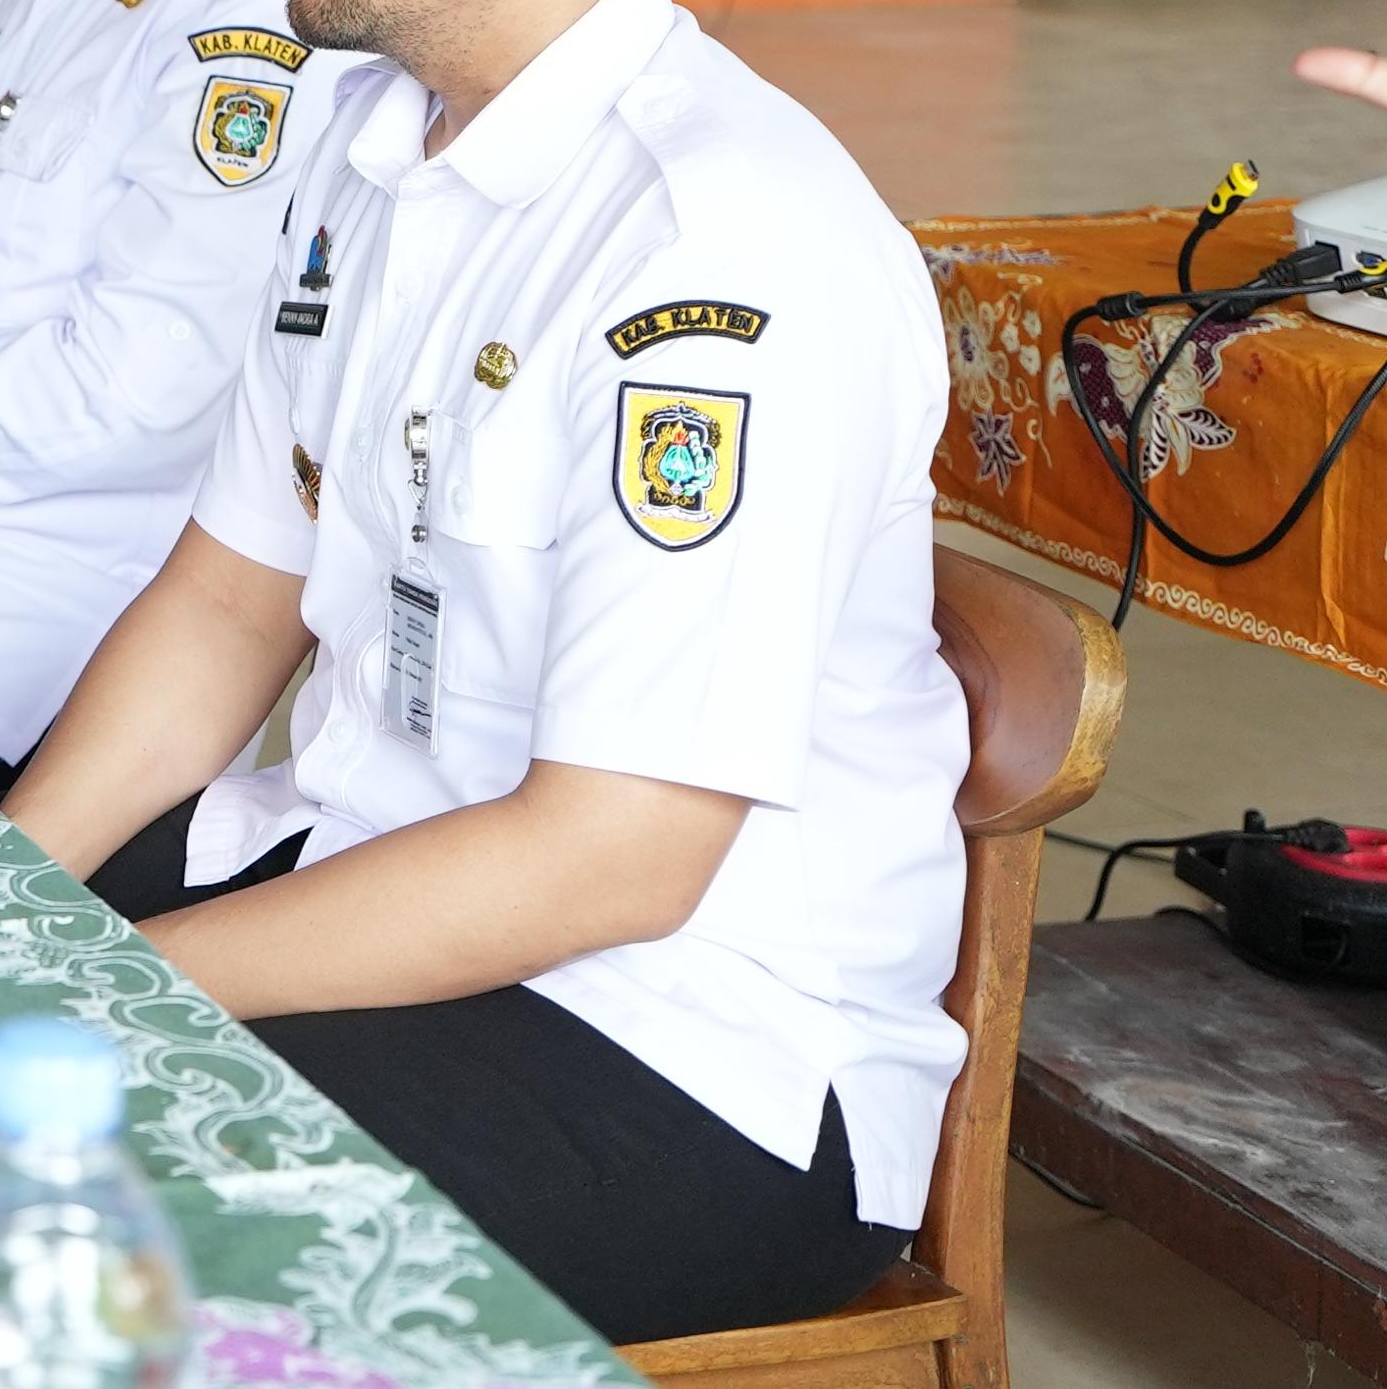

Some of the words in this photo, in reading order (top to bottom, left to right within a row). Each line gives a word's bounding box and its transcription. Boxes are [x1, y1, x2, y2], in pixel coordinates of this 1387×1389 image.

[198, 34, 239, 55] KAB.
[243, 33, 302, 65] KLATEN
[670, 306, 754, 334] KLATEN
